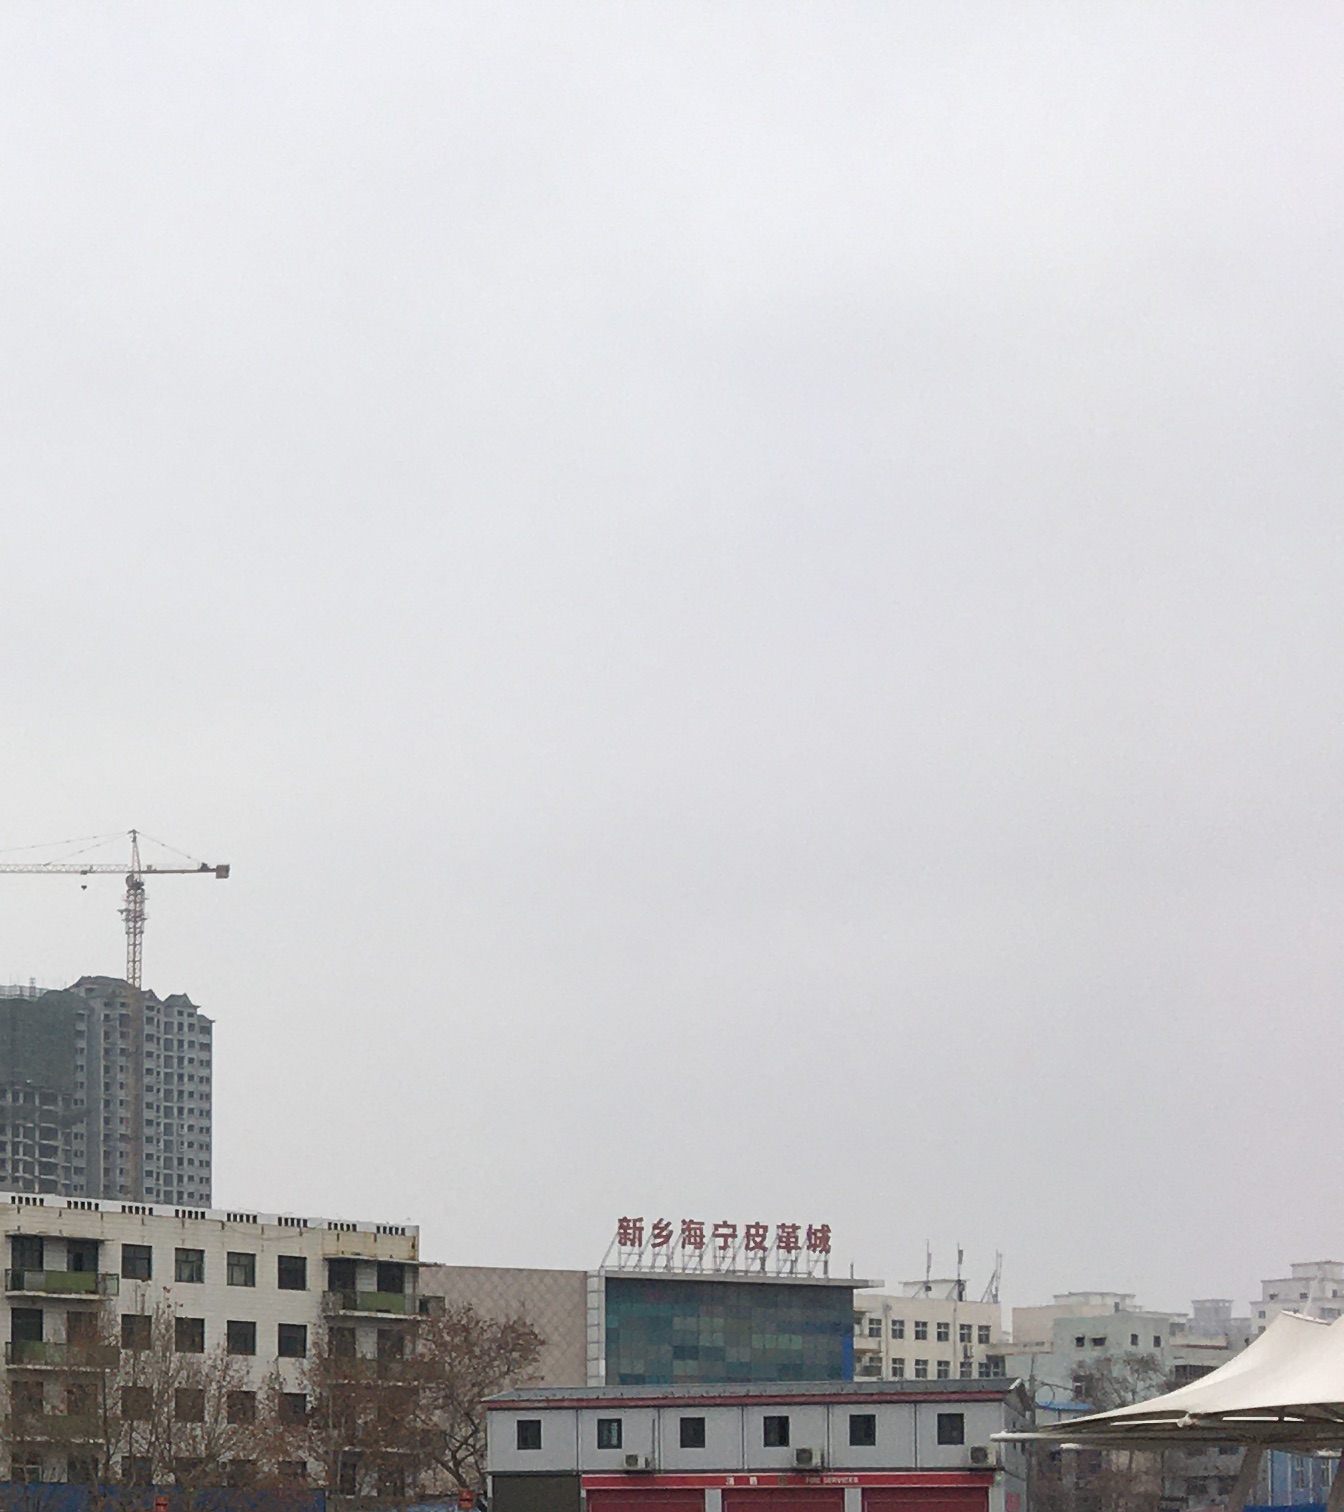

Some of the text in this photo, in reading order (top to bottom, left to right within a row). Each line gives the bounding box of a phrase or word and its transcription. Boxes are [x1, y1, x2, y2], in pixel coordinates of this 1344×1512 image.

[617, 1216, 832, 1254] 新乡海宁皮革城
